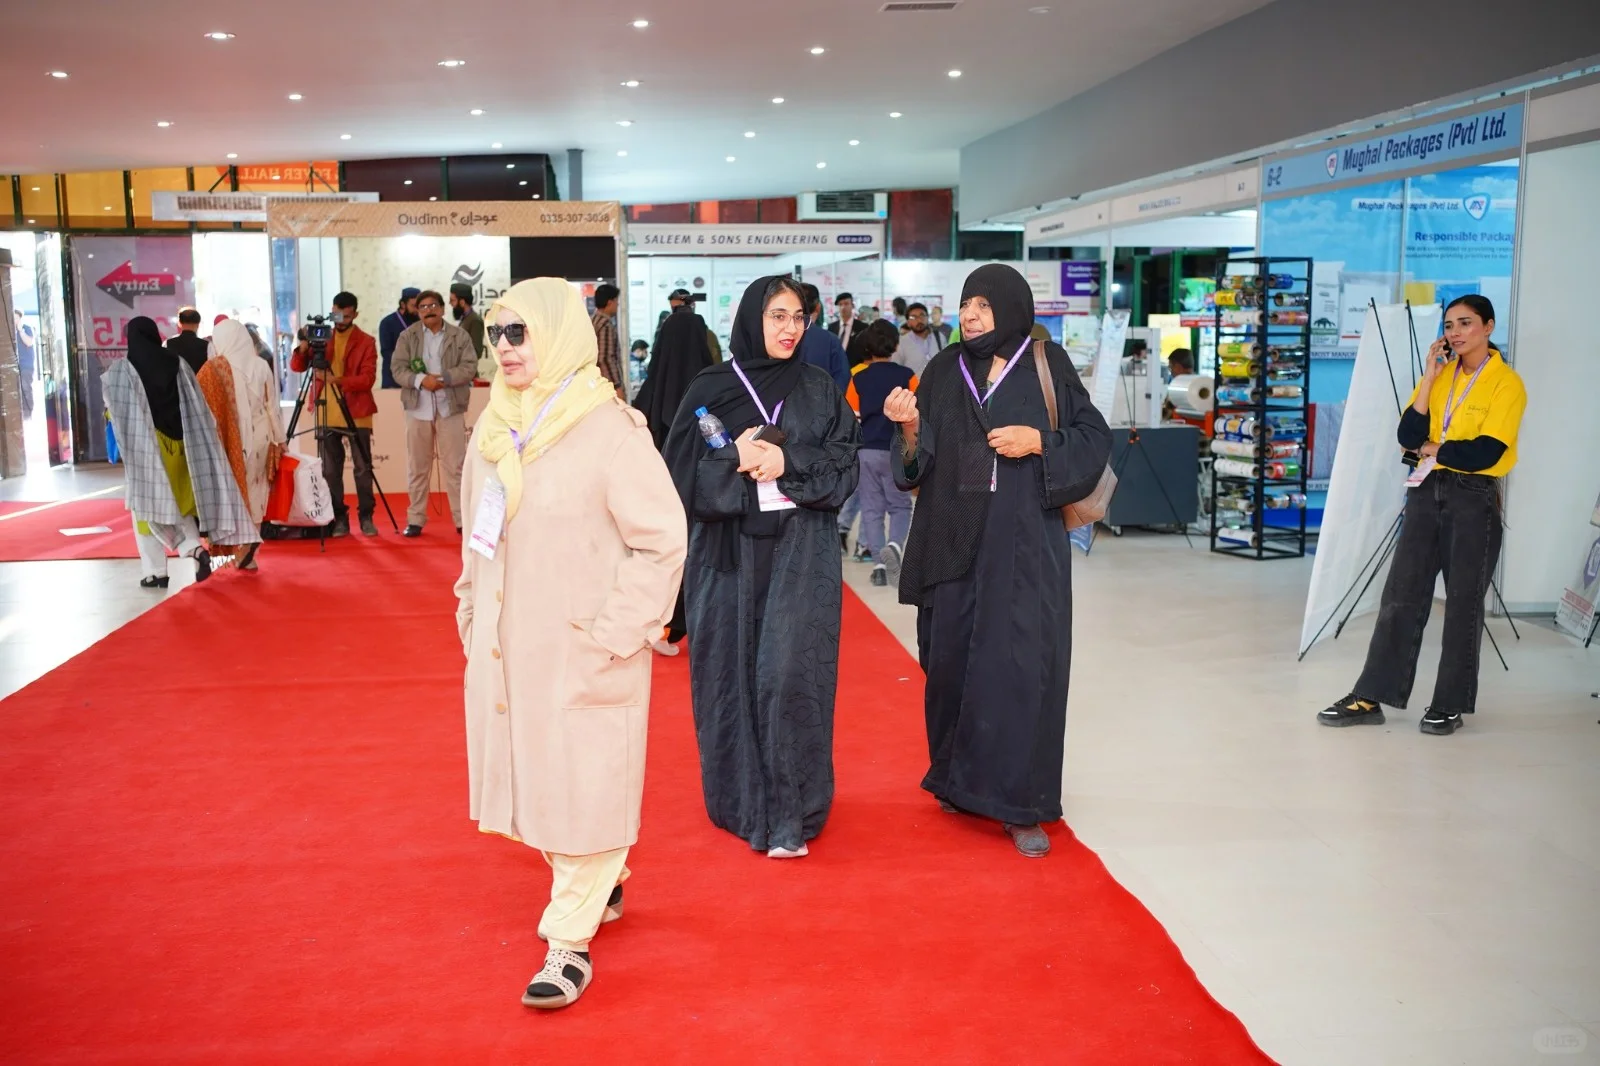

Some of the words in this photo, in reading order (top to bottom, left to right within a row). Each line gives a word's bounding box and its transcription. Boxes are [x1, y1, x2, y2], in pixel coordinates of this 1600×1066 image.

[1342, 141, 1383, 172] Mughal
[1385, 131, 1445, 161] Packages
[1447, 116, 1479, 150] (Pvt)
[1482, 111, 1507, 142] Ltd.
[1358, 201, 1385, 211] Mughal
[398, 213, 448, 226] Oudinn
[644, 234, 691, 245] SALEEM
[697, 234, 705, 245] &
[711, 234, 742, 245] SONS
[747, 234, 829, 245] ENGINEERING
[1414, 231, 1478, 244] Responsible
